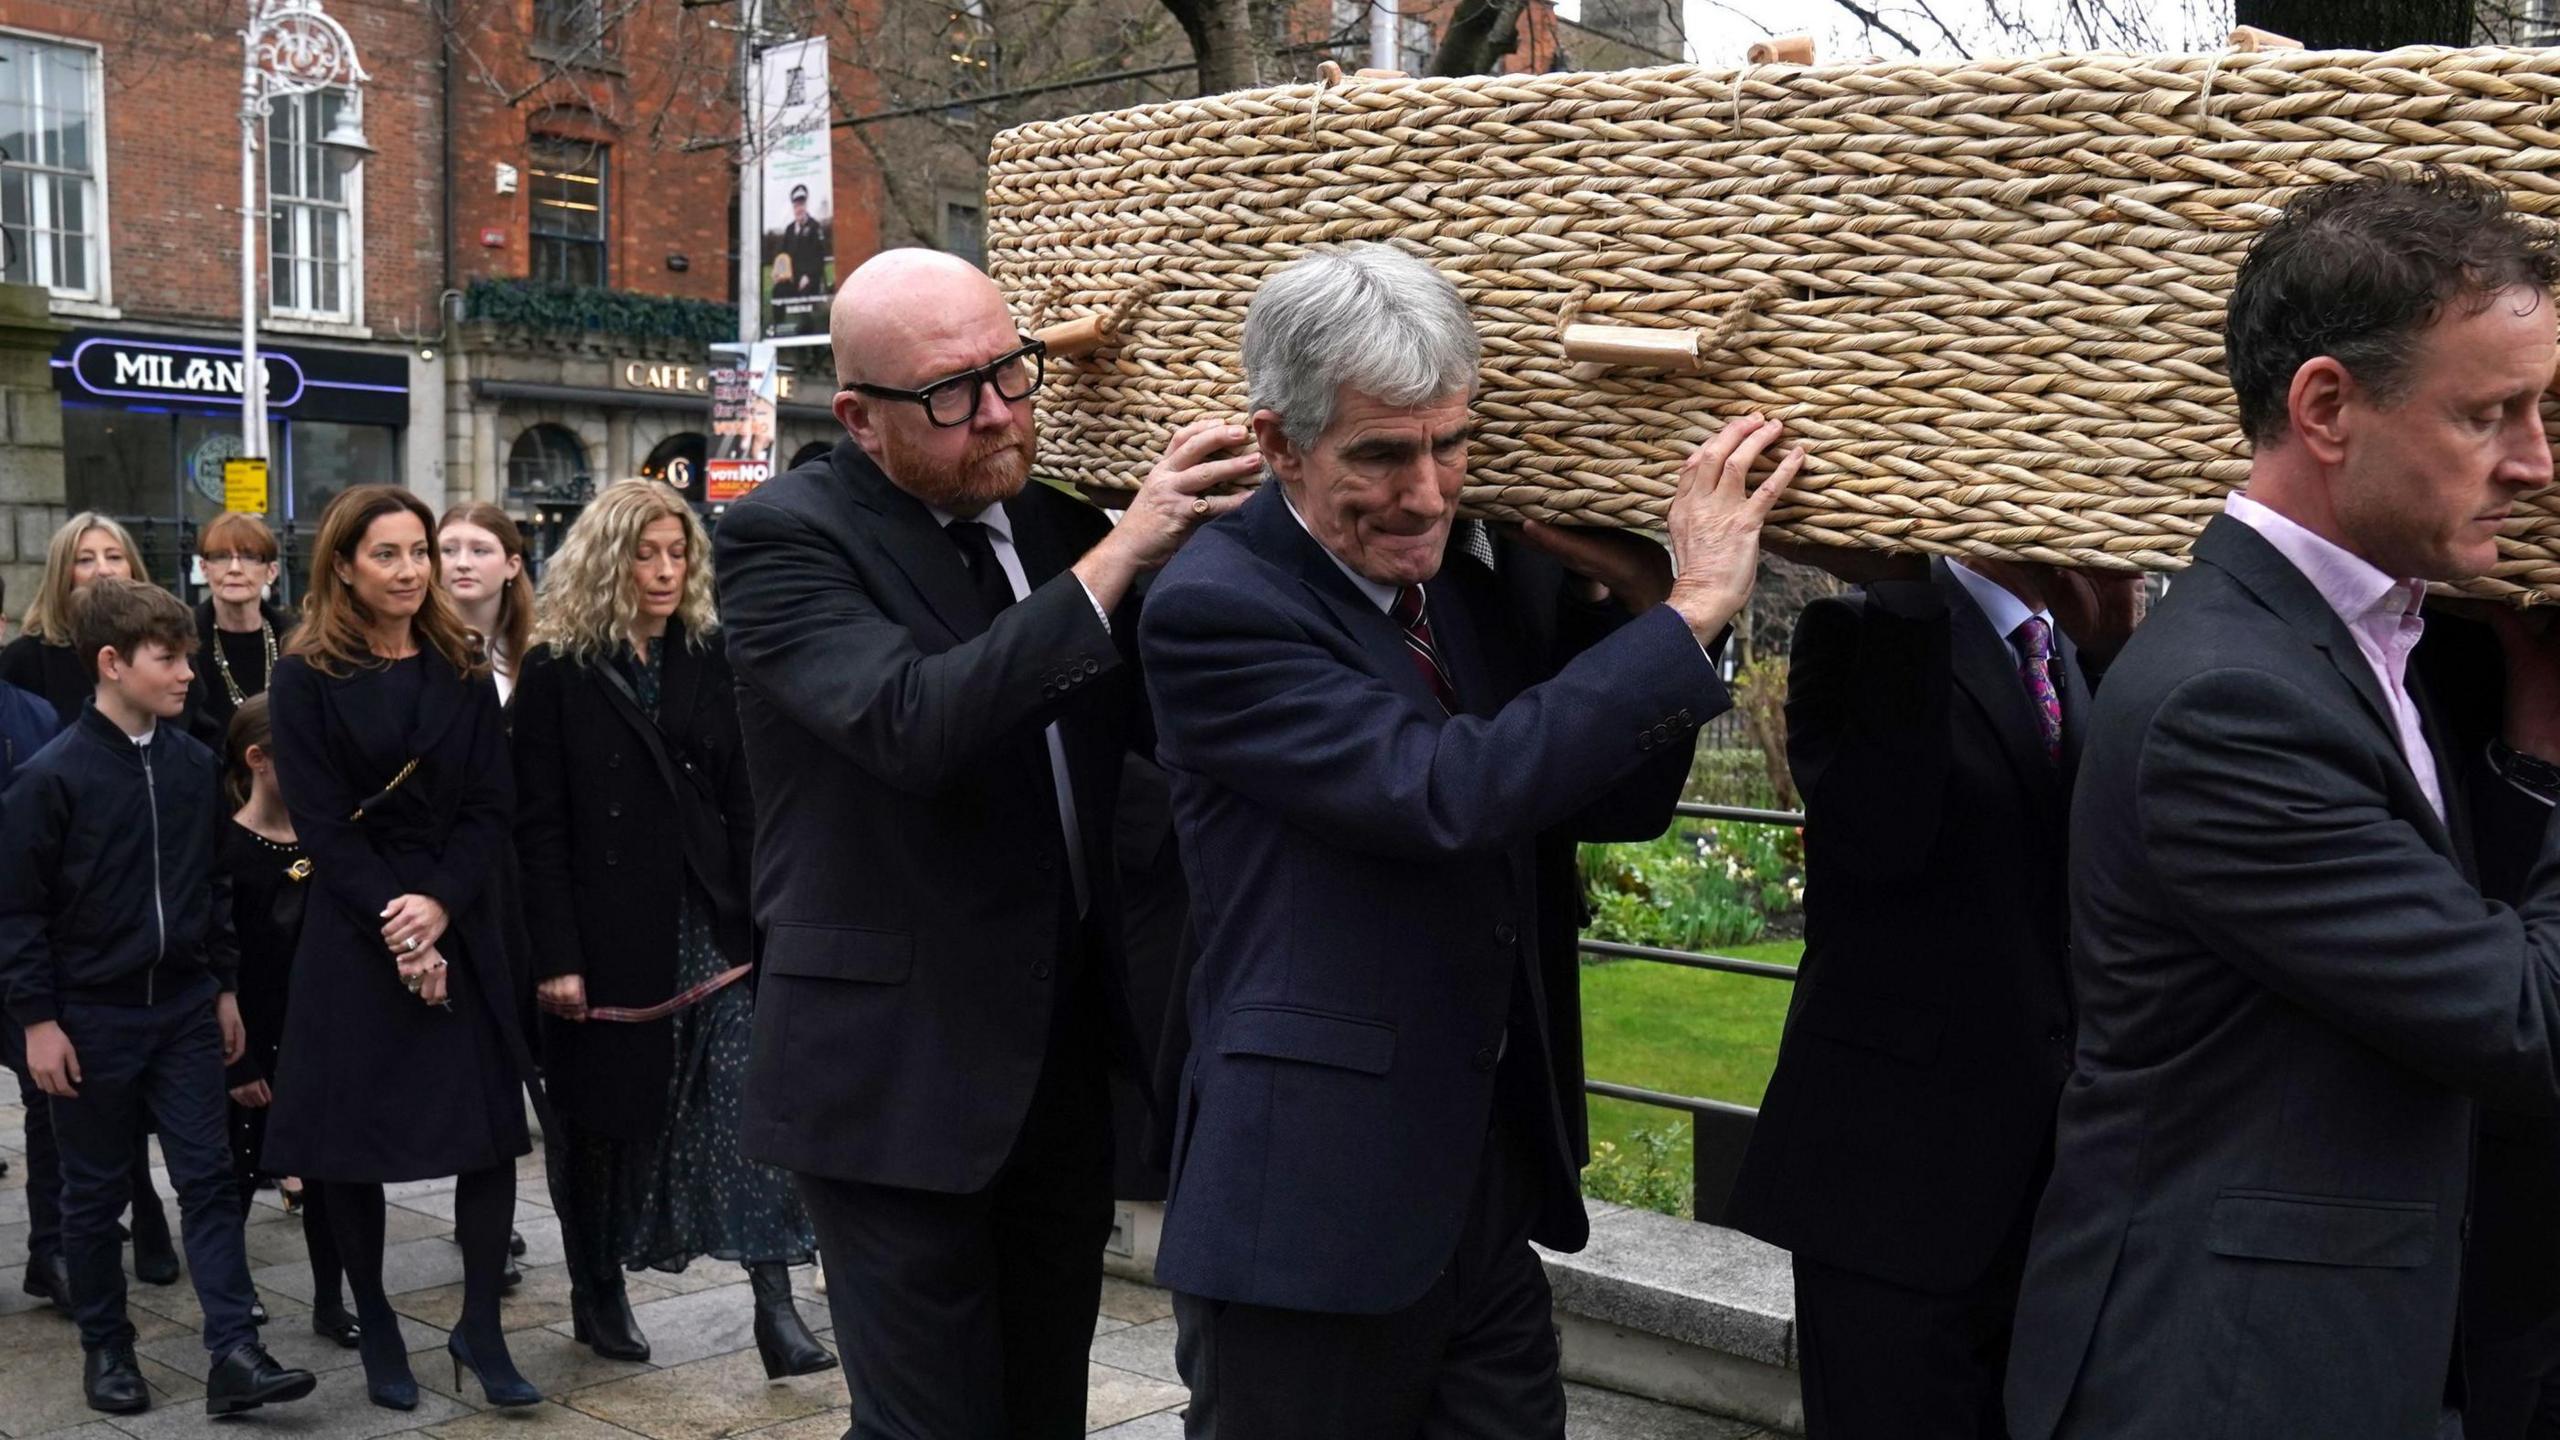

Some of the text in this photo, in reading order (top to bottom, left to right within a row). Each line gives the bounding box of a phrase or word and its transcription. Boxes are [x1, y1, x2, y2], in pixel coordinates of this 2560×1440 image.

[626, 361, 693, 392] CAFE
[710, 464, 768, 482] VOTE NO
